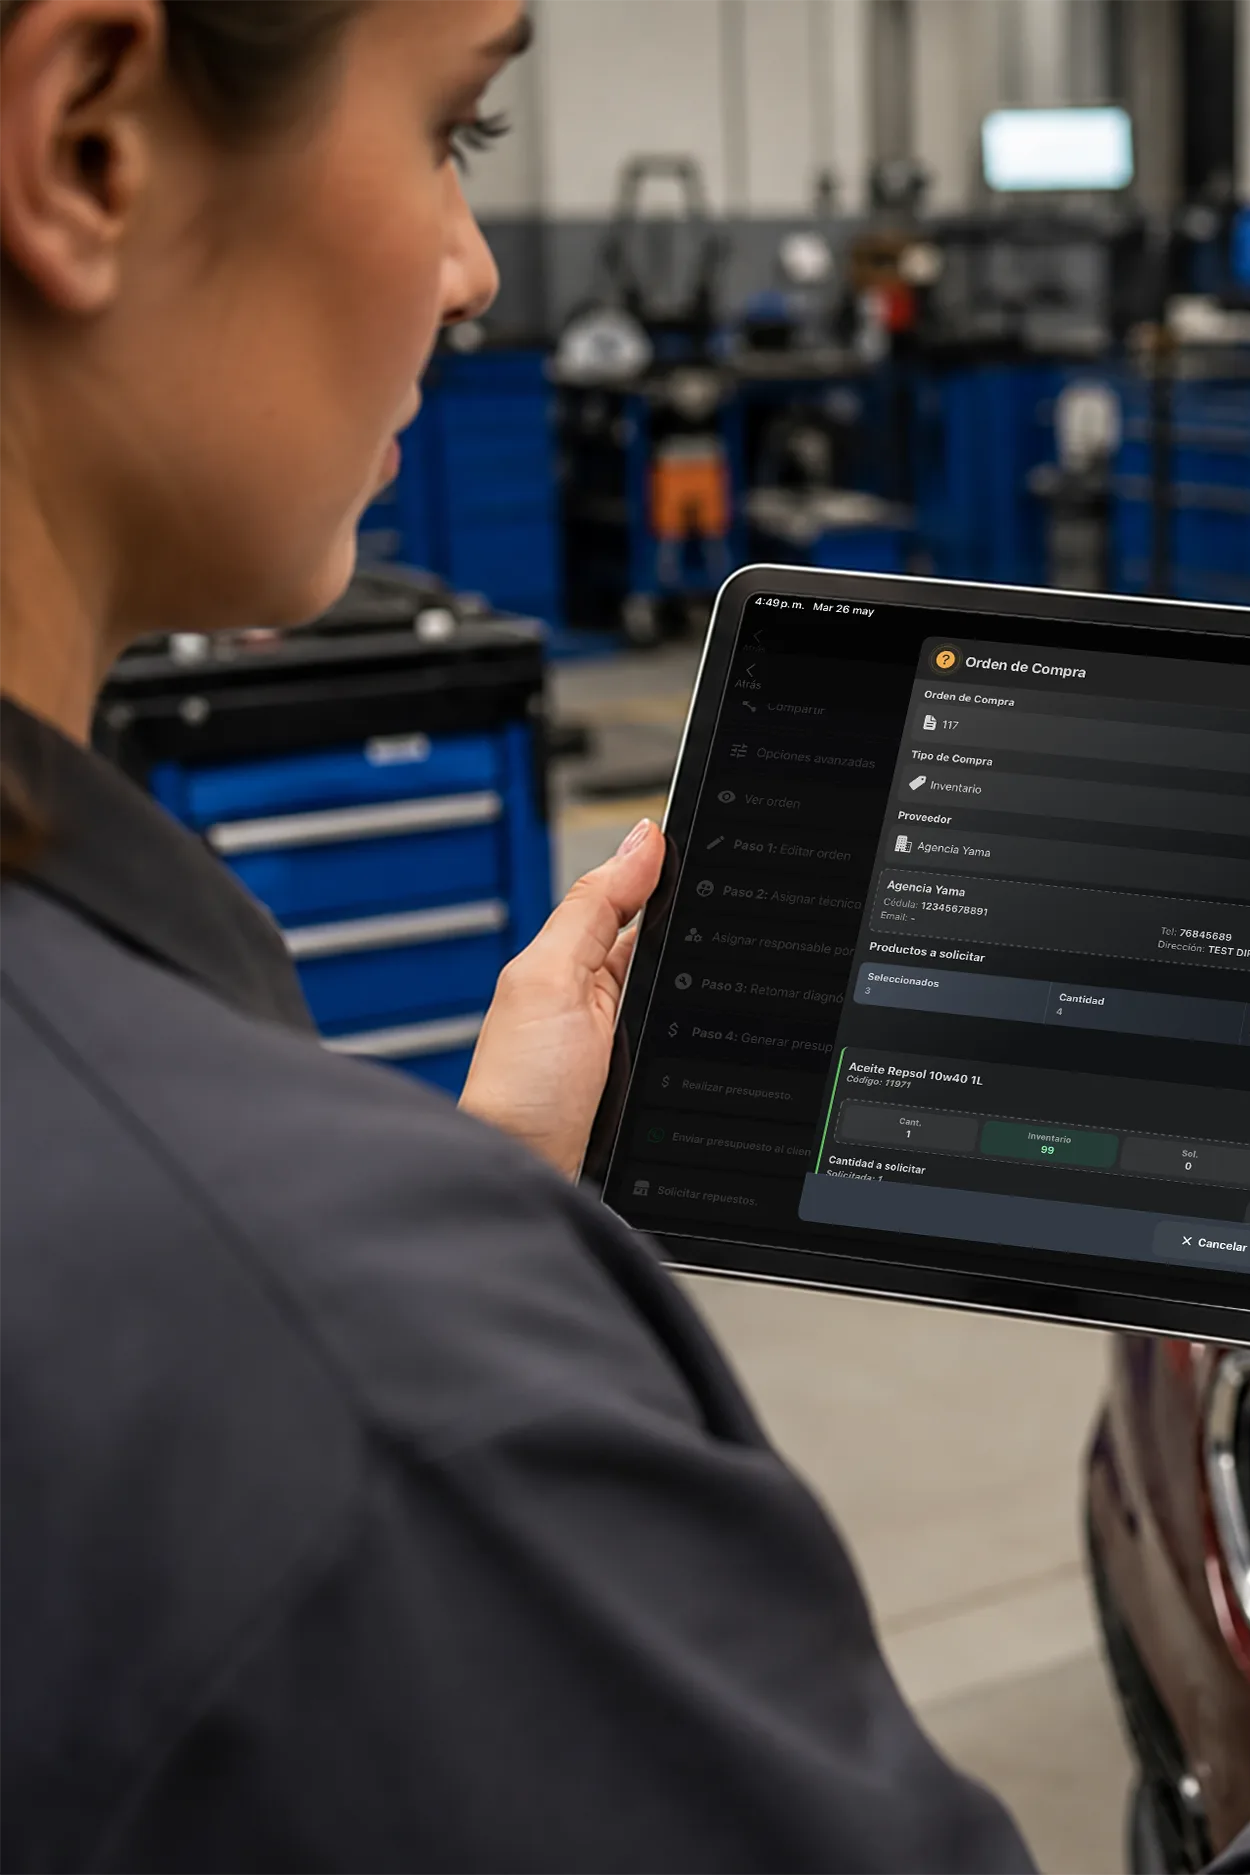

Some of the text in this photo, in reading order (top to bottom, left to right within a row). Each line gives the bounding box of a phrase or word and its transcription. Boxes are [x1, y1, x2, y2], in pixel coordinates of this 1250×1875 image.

[813, 602, 834, 612] Mar
[836, 604, 850, 614] 26
[852, 607, 875, 618] may
[965, 656, 1087, 679] Orden de Compra
[924, 690, 1015, 707] Orden de Compra
[942, 720, 959, 730] 117
[756, 747, 876, 769] Opciones avanzadas
[911, 750, 993, 767] Tipo de Compra
[930, 781, 982, 795] Inventario
[745, 793, 801, 810] Ver orden
[897, 811, 952, 825] Proveedor
[733, 839, 851, 862] Paso 1: Editar orden
[917, 842, 991, 858] Agencia Yama
[887, 880, 966, 897] Agencia Yama
[722, 885, 862, 910] Paso 2: Asignar técnico
[883, 897, 988, 916] Cédula: 12345678891
[880, 911, 908, 921] Email:
[1161, 926, 1232, 942] Tel: 76845689
[711, 931, 855, 957] Asignar responsable por
[869, 941, 986, 963] Productos a solicitar
[1157, 940, 1205, 953] Dirección:
[1208, 945, 1234, 956] TEST
[867, 972, 940, 988] Seleccionados
[701, 978, 844, 1004] Paso 3: Retomar diagnó
[864, 986, 871, 995] 3
[1059, 993, 1105, 1006] Cantidad
[1056, 1007, 1063, 1015] 4
[692, 1026, 722, 1040] Paso
[724, 1030, 738, 1042] 4:
[740, 1032, 789, 1048] Generar
[791, 1039, 833, 1054] presup
[846, 1074, 912, 1089] Código: 11971
[848, 1062, 983, 1086] Aceite Repsol 10w40 1L
[682, 1078, 724, 1093] Realizar
[899, 1117, 922, 1127] Cant.
[672, 1132, 705, 1145] Enviar
[706, 1137, 772, 1152] presupuesto
[905, 1130, 911, 1138] 1
[1027, 1132, 1072, 1144] Inventario
[1040, 1145, 1055, 1155] 99
[1181, 1149, 1199, 1159] Sol.
[828, 1155, 926, 1175] Cantidad a solicitar
[1184, 1162, 1193, 1171] 0
[657, 1185, 701, 1199] Solicitar
[1198, 1238, 1248, 1253] Cancelar
